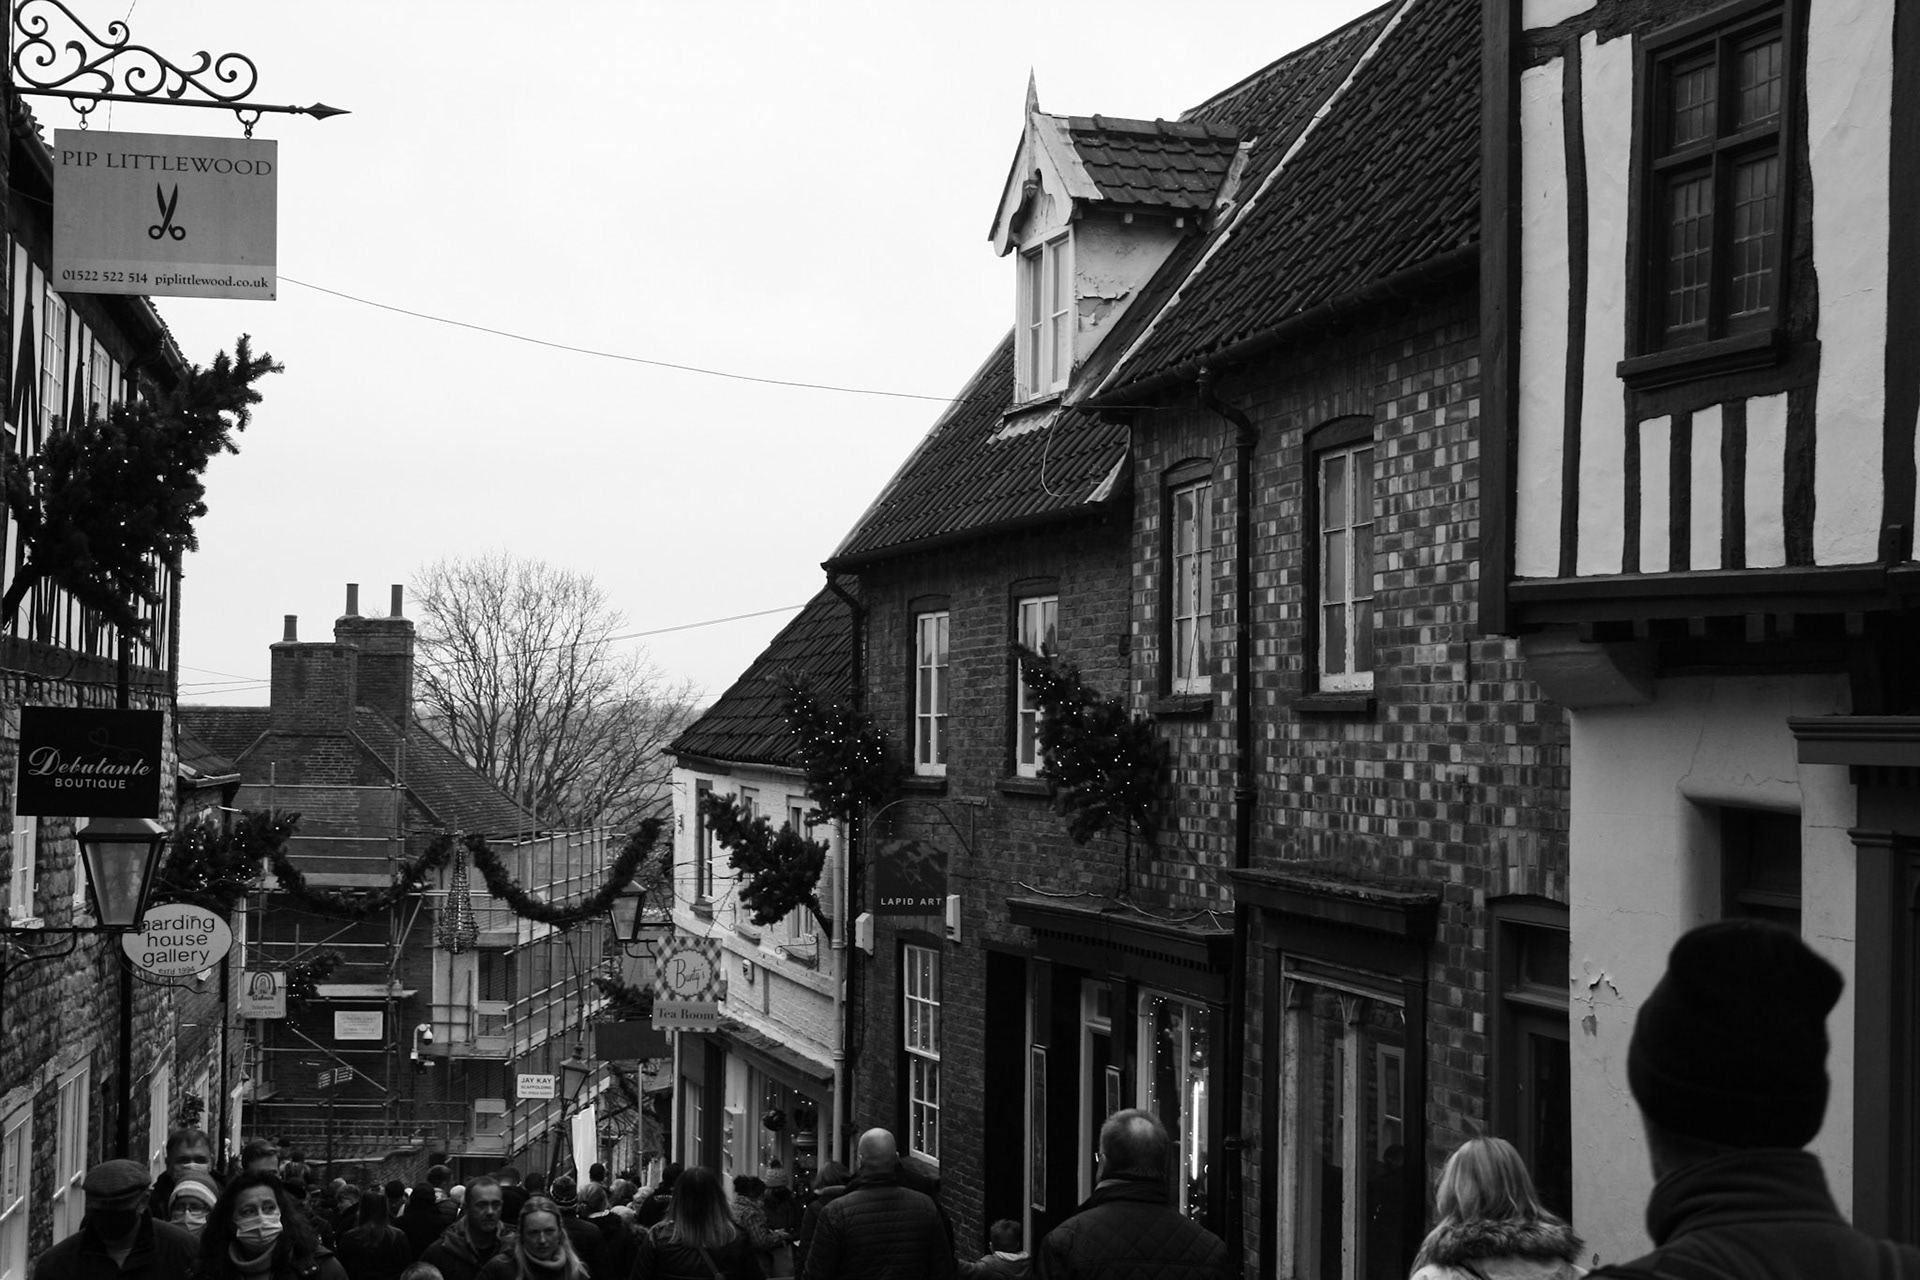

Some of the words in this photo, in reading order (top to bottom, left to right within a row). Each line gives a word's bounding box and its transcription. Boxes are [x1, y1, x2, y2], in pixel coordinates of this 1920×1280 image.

[61, 151, 98, 167] PIP
[106, 154, 272, 176] LITTLEWOOD
[62, 269, 98, 281] 01522
[102, 271, 124, 282] 522
[128, 273, 148, 284] 514
[155, 273, 269, 288] piplittlewood.co.uk
[28, 746, 154, 776] Debutante
[54, 778, 126, 789] BOUTIQUE
[880, 897, 914, 905] LAPID
[920, 897, 942, 905] ART
[147, 933, 208, 947] house
[142, 949, 210, 968] gallery
[656, 1007, 677, 1019] Tea
[681, 1008, 714, 1020] Room
